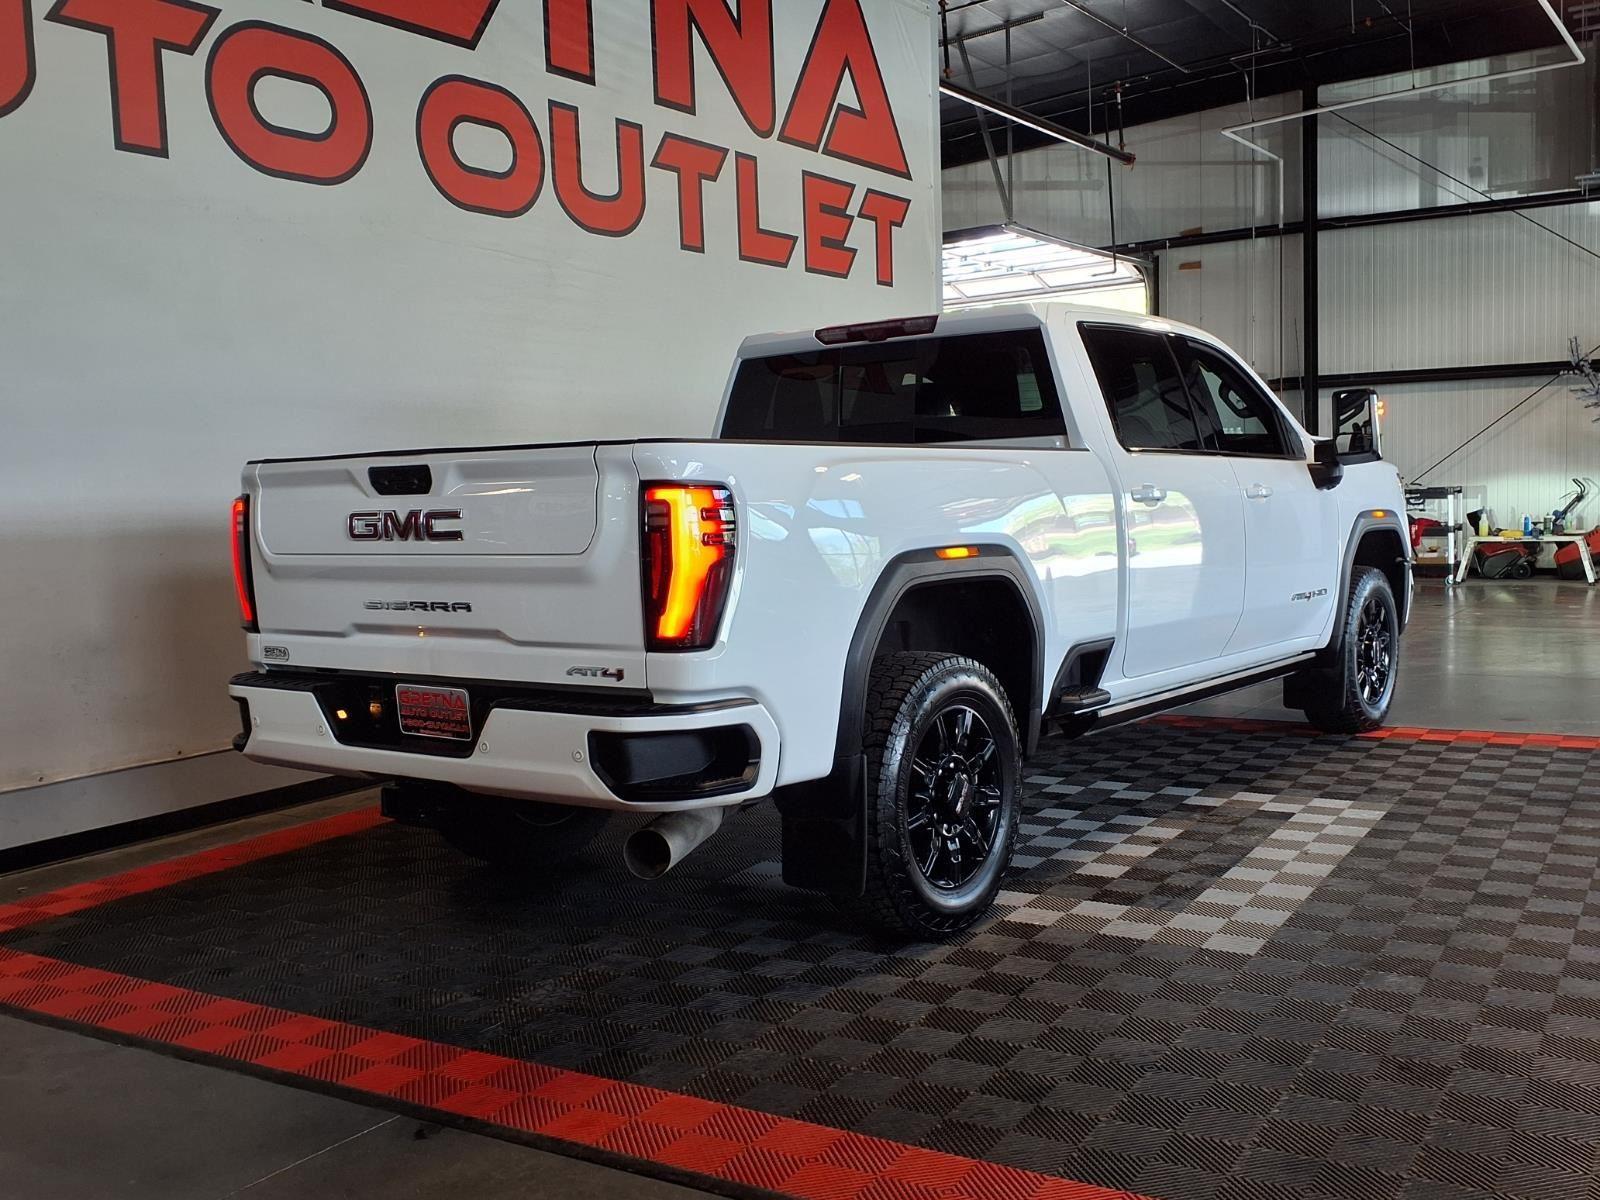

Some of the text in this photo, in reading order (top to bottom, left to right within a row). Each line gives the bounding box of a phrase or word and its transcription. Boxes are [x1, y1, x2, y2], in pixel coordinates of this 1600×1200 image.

[415, 73, 911, 288] OUTLET
[348, 508, 464, 541] GMC
[364, 600, 472, 613] SIERRA
[566, 665, 625, 682] AT4
